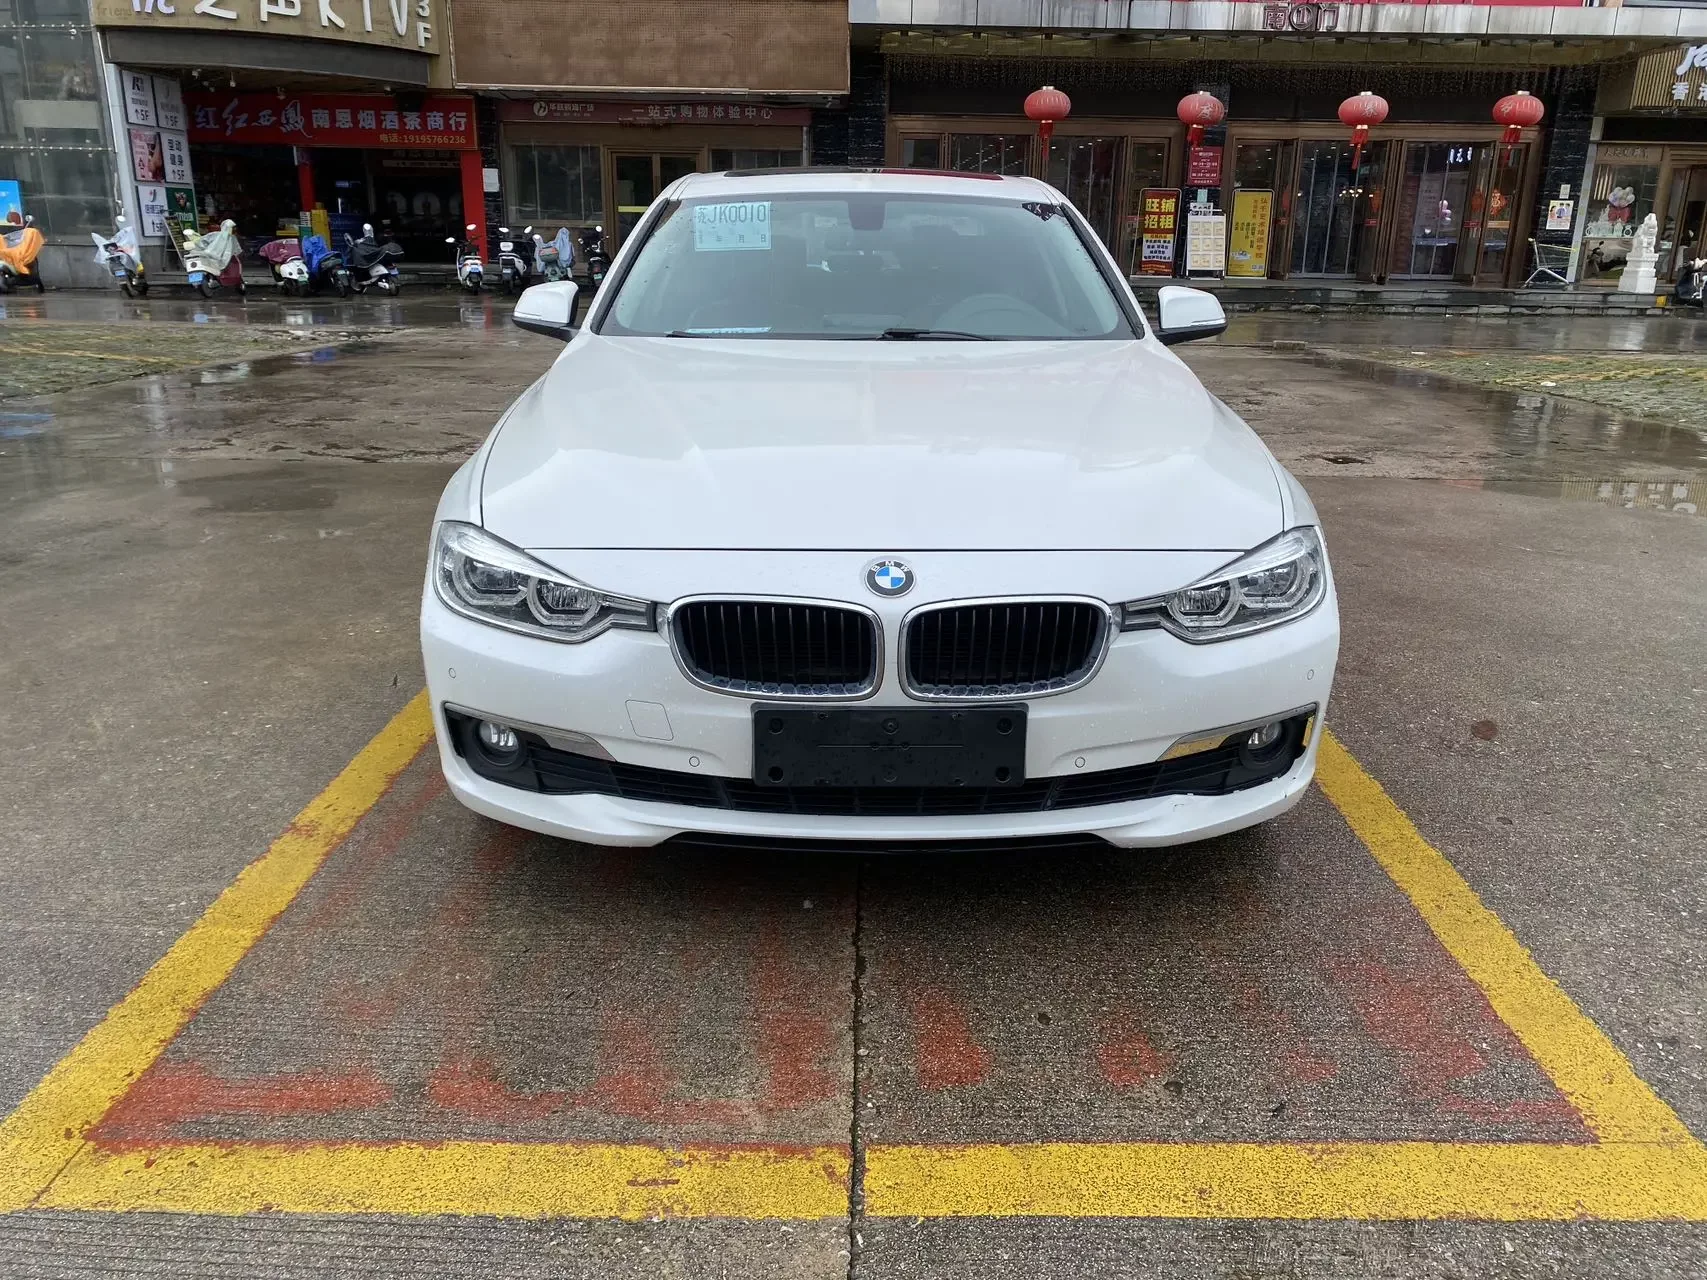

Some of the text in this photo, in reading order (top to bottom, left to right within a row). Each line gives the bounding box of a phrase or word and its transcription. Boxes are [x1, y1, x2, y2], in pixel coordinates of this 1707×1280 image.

[631, 104, 773, 120] 一站式购物体验中心
[1145, 198, 1177, 213] 旺铺
[1144, 214, 1174, 229] 招租
[871, 560, 910, 573] BMW
